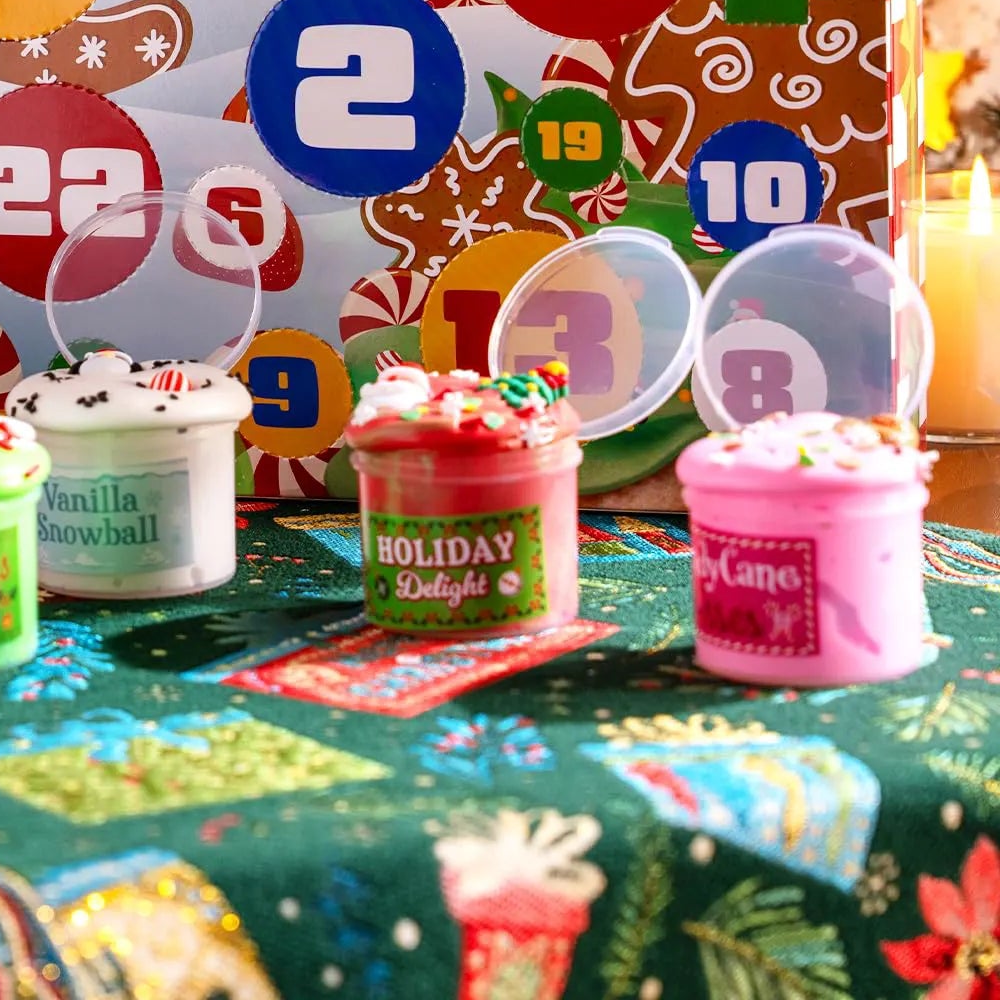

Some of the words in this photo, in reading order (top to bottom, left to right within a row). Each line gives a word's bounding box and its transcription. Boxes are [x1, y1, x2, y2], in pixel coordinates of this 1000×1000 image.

[295, 25, 416, 151] 2
[537, 121, 602, 161] 19
[207, 187, 264, 246] 6
[698, 161, 807, 223] 10
[443, 290, 614, 395] 13
[249, 356, 320, 428] 9
[721, 349, 793, 423] 8
[43, 482, 139, 513] Vanilla
[38, 513, 160, 546] Snowball
[377, 531, 514, 567] HOLIDAY
[396, 570, 489, 608] Delight
